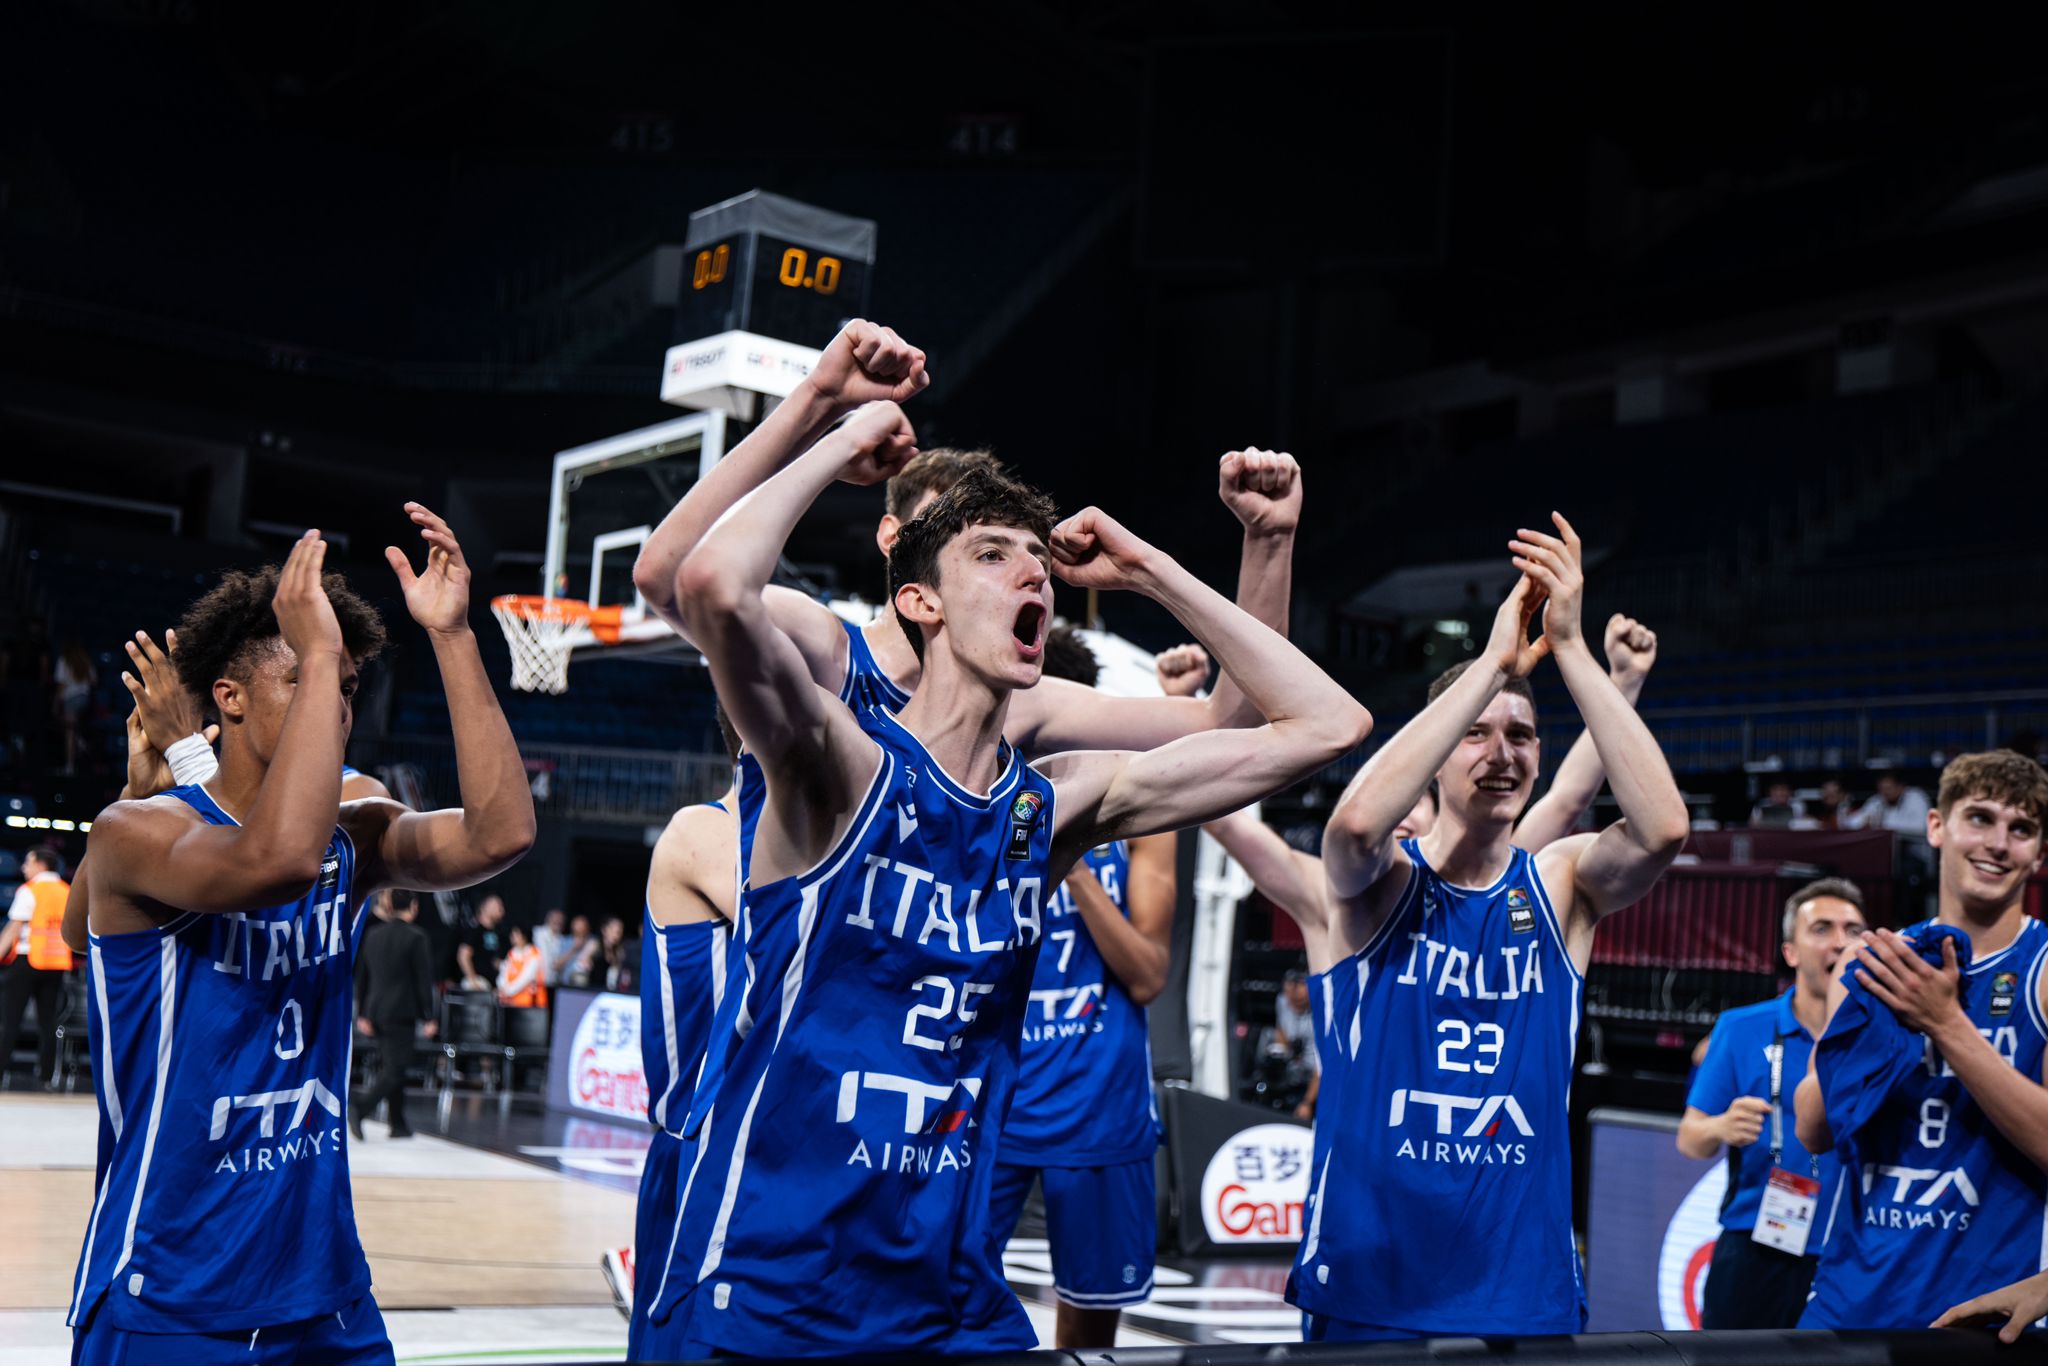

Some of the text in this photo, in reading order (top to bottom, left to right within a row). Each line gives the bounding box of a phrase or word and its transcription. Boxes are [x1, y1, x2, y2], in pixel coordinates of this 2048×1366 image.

[779, 247, 842, 295] 0.0
[320, 860, 339, 873] FIBA
[1051, 929, 1076, 973] 7
[1397, 932, 1544, 1000] ITALIA
[274, 998, 304, 1060] 0
[902, 975, 995, 1052] 25
[1437, 1019, 1505, 1075] 23
[208, 1077, 341, 1141] ITA
[1389, 1088, 1535, 1137] ITA
[1918, 1097, 1951, 1149] 8
[215, 1127, 341, 1174] AIRWAYS
[1396, 1138, 1526, 1165] AIRWAYS
[1862, 1163, 1980, 1206] ITA
[1864, 1206, 1971, 1231] AIRWAYS
